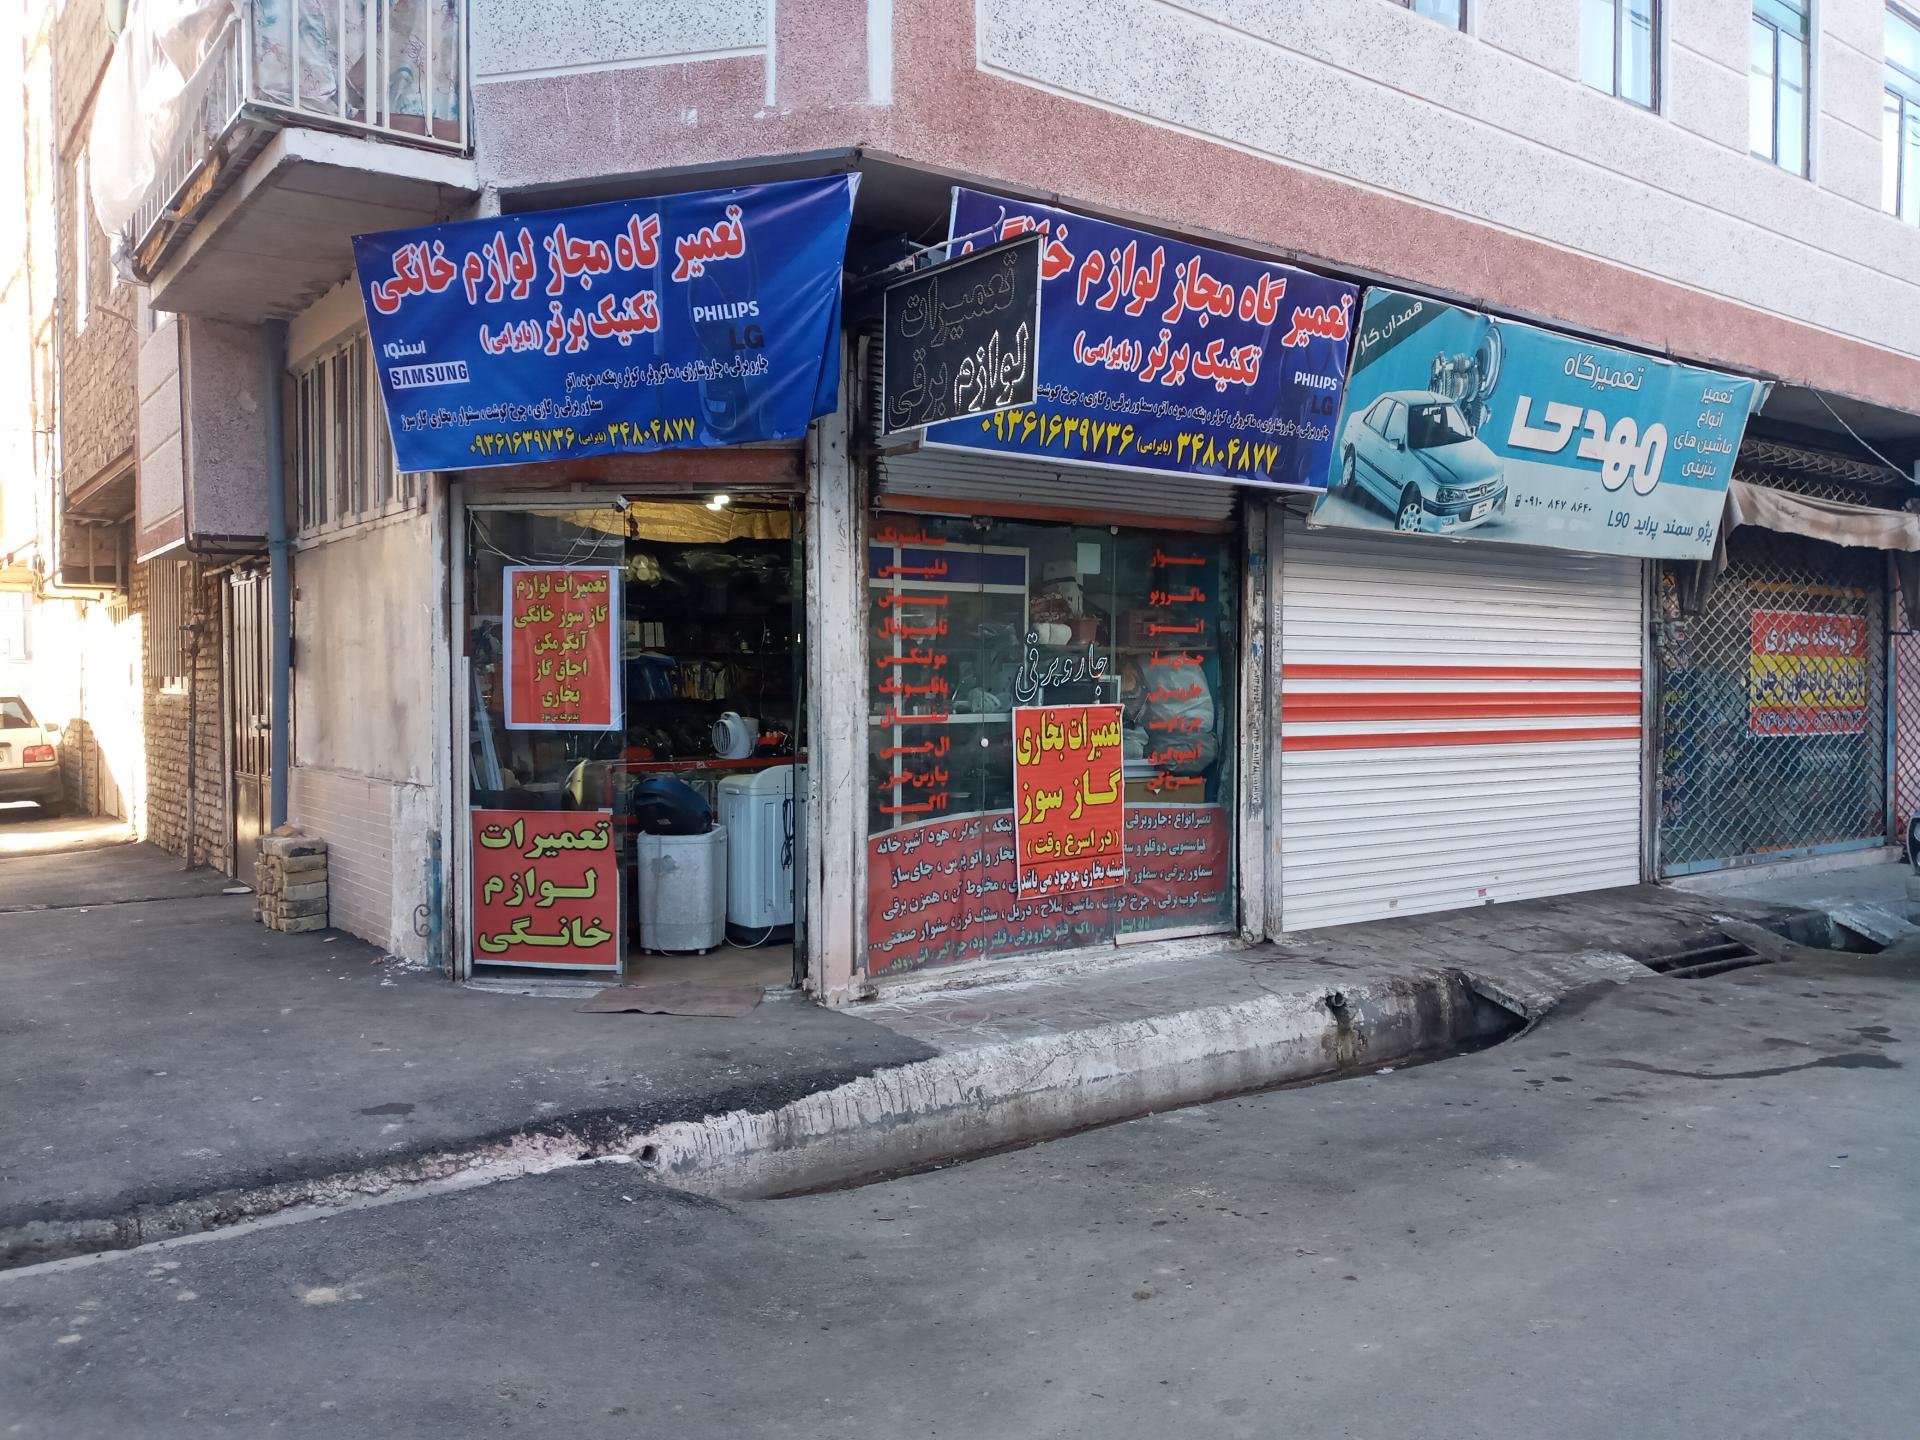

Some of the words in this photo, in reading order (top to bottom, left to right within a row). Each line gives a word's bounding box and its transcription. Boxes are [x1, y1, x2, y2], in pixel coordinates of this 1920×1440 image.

[543, 223, 613, 297] مجاز
[616, 213, 660, 271] گاه
[672, 205, 745, 282] تعمیر
[371, 239, 457, 314] خانگی
[464, 227, 537, 305] لوازم
[1076, 240, 1166, 317] لوازم
[692, 301, 760, 322] PHILIPS
[900, 250, 1019, 349] تعمیرات
[1162, 255, 1235, 328] مجاز
[1239, 272, 1287, 325] گاه
[479, 319, 543, 356] (بایرامی)
[544, 301, 588, 356] برتر
[588, 290, 661, 346] تکنیک
[728, 324, 765, 350] LG
[1281, 293, 1353, 348] تعمیر
[1382, 300, 1424, 341] همدان
[1073, 330, 1143, 373] (بایرامی)
[1138, 328, 1191, 386] برتر
[1359, 326, 1382, 357] کار
[391, 362, 469, 387] SAMSUNG
[954, 320, 1030, 415] لوازم
[1192, 338, 1262, 392] تکنیک
[1293, 370, 1338, 395] PHILIPS
[1563, 352, 1646, 392] تعمیرگاه
[888, 347, 949, 428] برقی
[1311, 394, 1335, 418] LG
[1699, 387, 1736, 410] تعمیر
[1696, 413, 1725, 436] انواع
[1177, 431, 1279, 475] ۳۴۸۰۴۸۷۷
[1680, 463, 1718, 487] بنزینی
[1633, 514, 1660, 541] پراید
[1661, 519, 1694, 538] سمند
[1694, 518, 1714, 547] پژو
[515, 574, 552, 600] لوازم
[554, 573, 607, 600] تعمیرات
[513, 604, 555, 629] خانگی
[557, 608, 585, 629] سوز
[587, 603, 608, 629] گاز
[533, 658, 553, 683] گاز
[555, 658, 588, 682] اجاق
[541, 683, 582, 708] بخاری
[1016, 710, 1067, 767] بخاری
[1068, 708, 1122, 764] تعمیرات
[1019, 777, 1064, 826] سوز
[1069, 768, 1122, 821] گاز
[479, 816, 611, 860] تعمیرات
[1063, 828, 1096, 858] اسرع
[482, 865, 600, 908] لوازم
[1054, 867, 1080, 892] موجود
[1080, 860, 1105, 889] بخاری
[478, 915, 613, 954] خانگی
